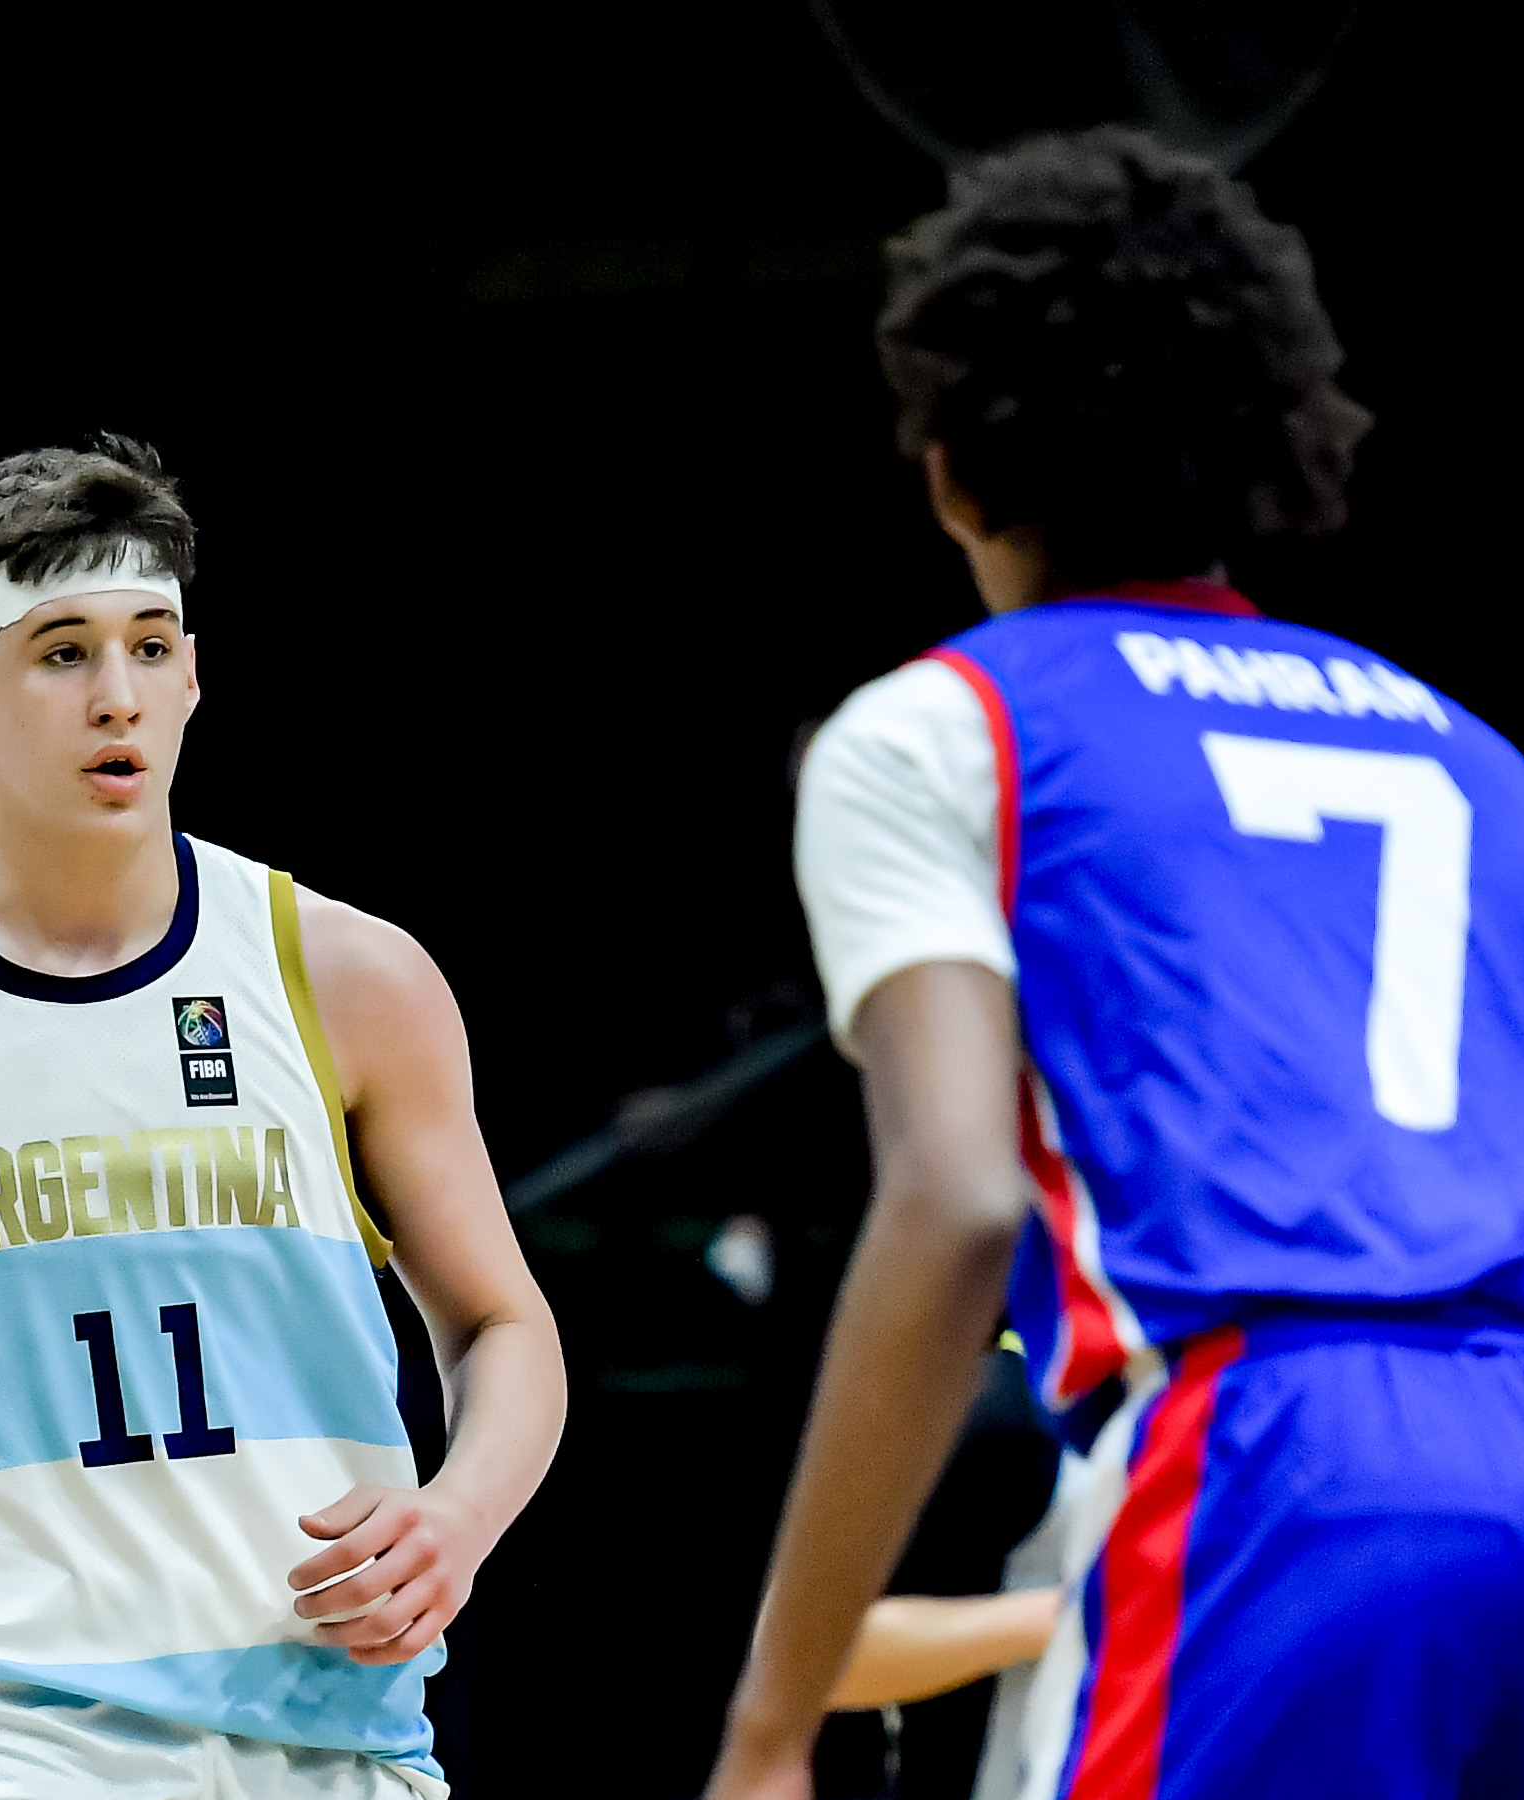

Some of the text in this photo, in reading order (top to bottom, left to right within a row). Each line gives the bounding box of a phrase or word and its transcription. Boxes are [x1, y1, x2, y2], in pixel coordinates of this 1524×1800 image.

[1200, 730, 1473, 1133] 7
[188, 1058, 227, 1079] FIBA
[73, 1302, 236, 1468] 11
